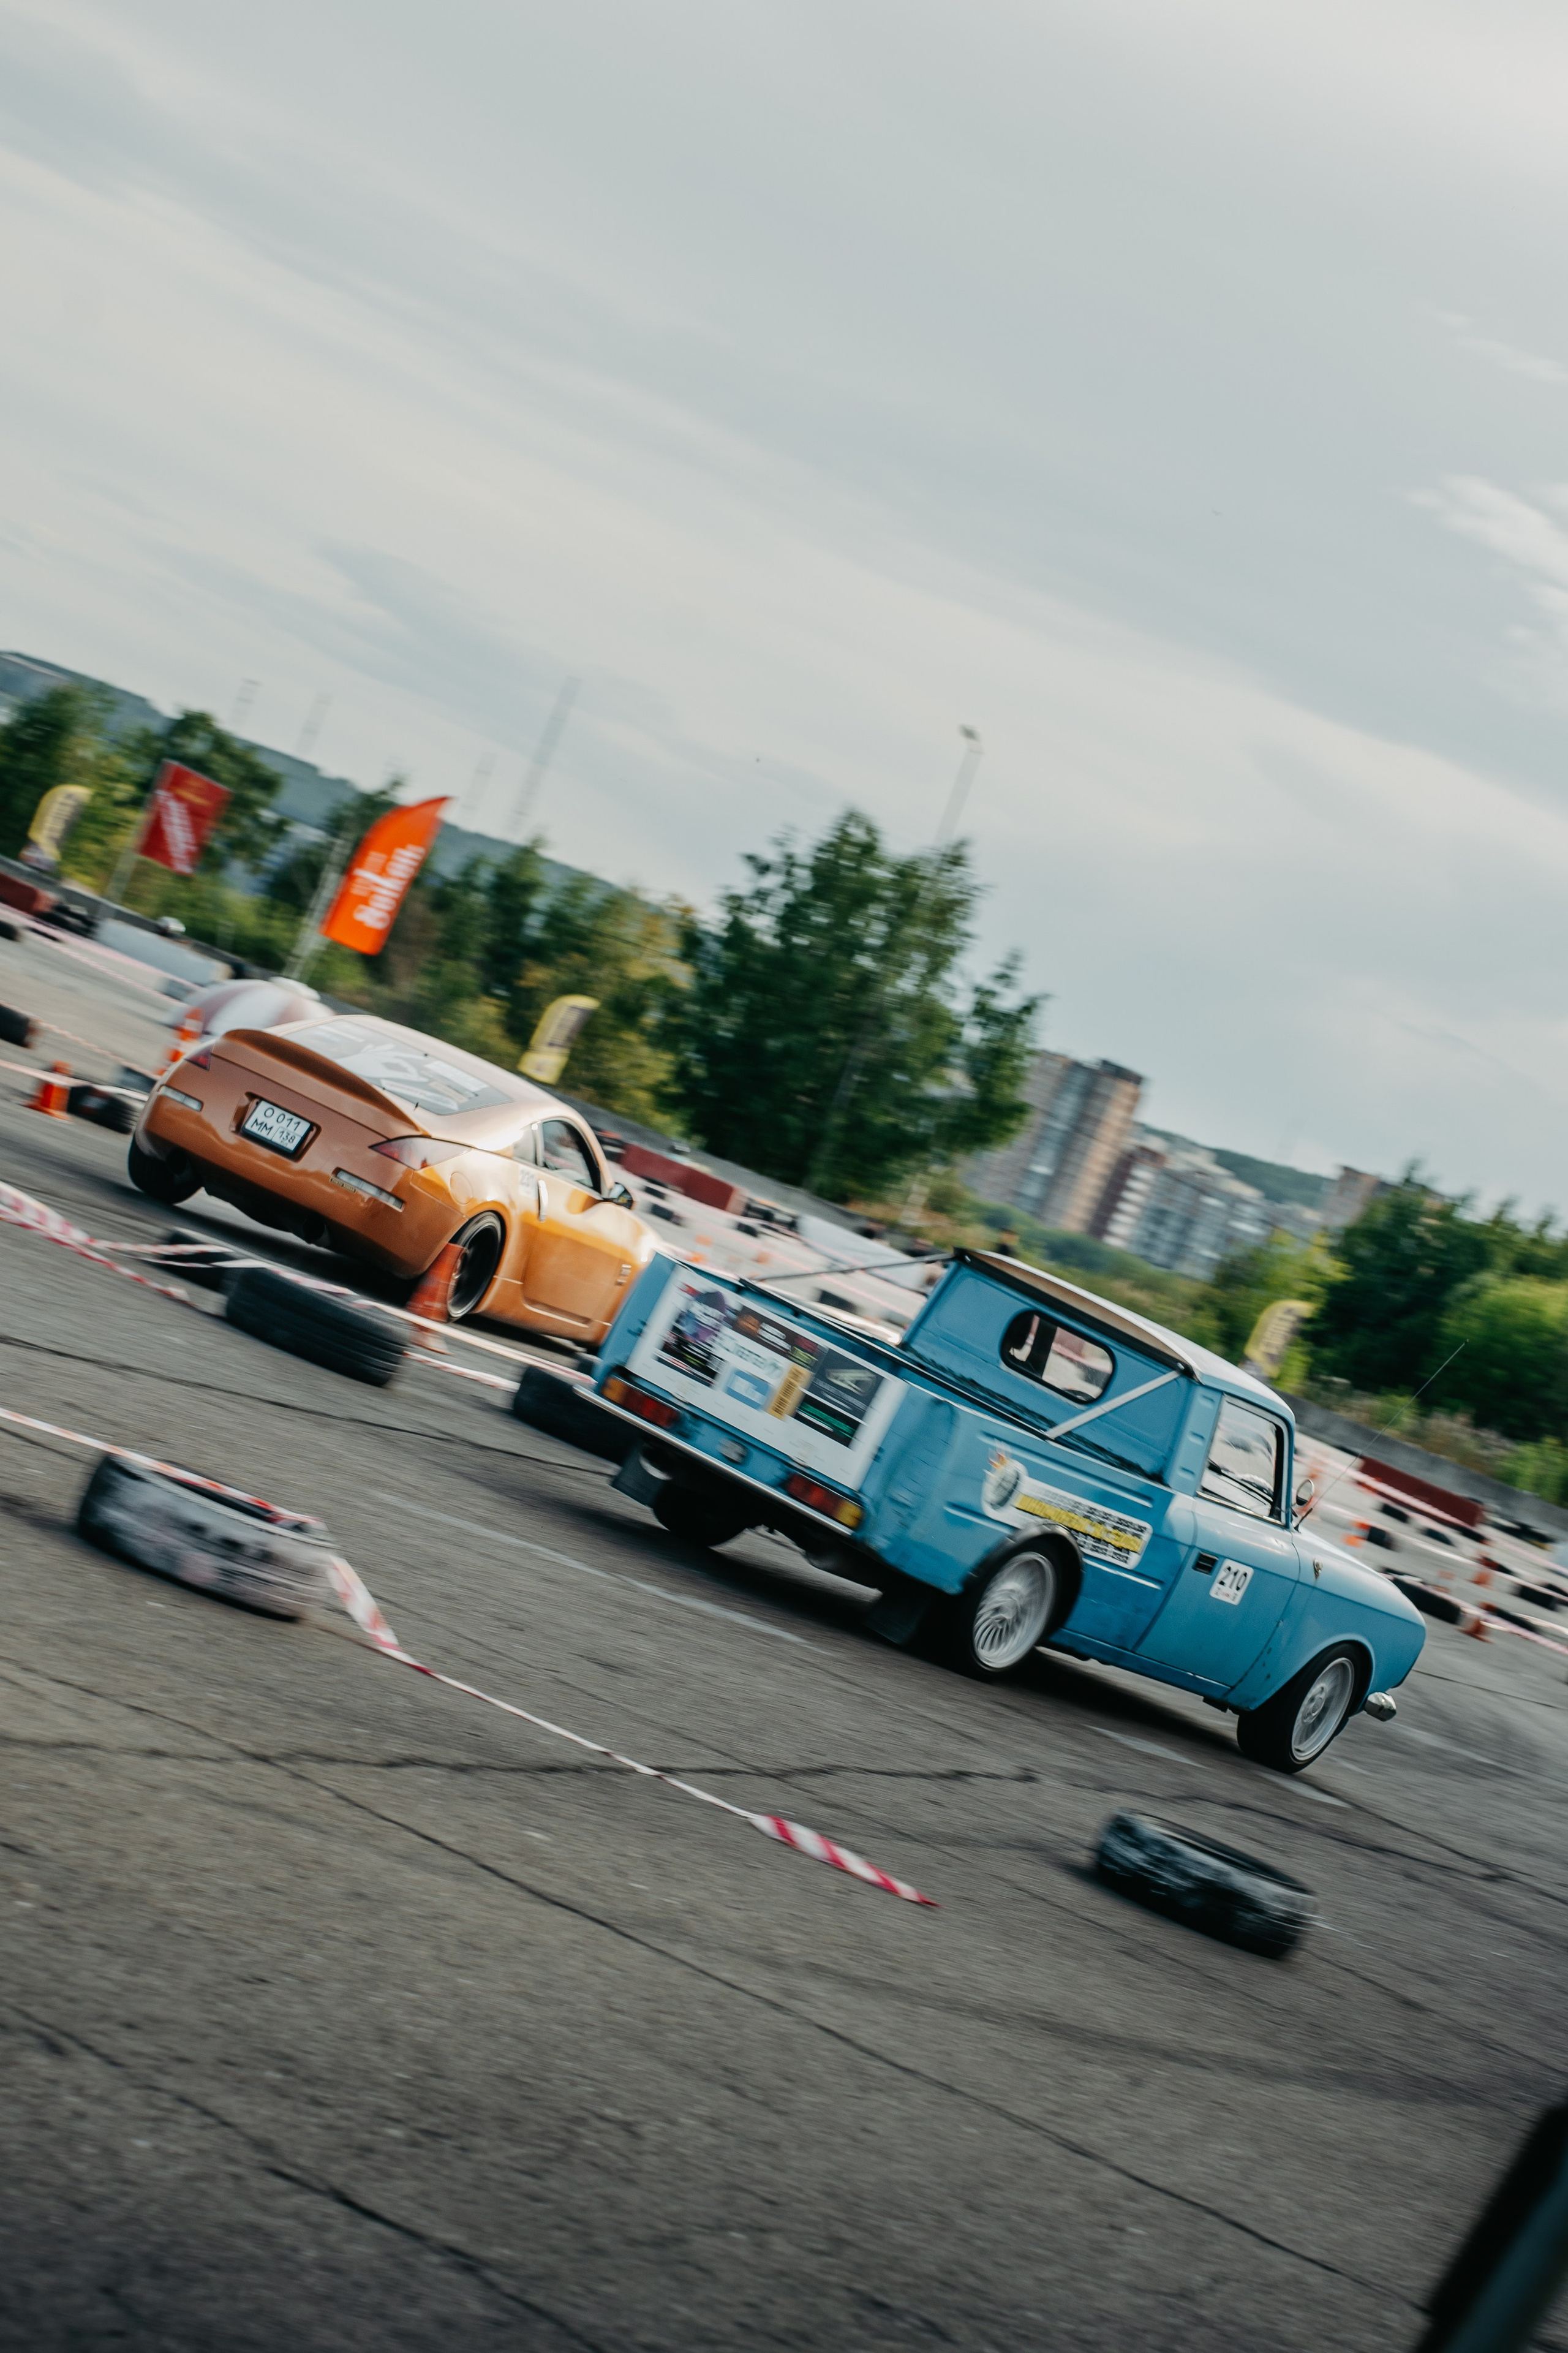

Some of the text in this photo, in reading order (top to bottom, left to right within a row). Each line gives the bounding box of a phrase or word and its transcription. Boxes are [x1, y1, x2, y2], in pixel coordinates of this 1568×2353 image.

[276, 1113, 301, 1131] 011
[279, 1131, 296, 1144] 138
[1217, 1566, 1248, 1591] 210
